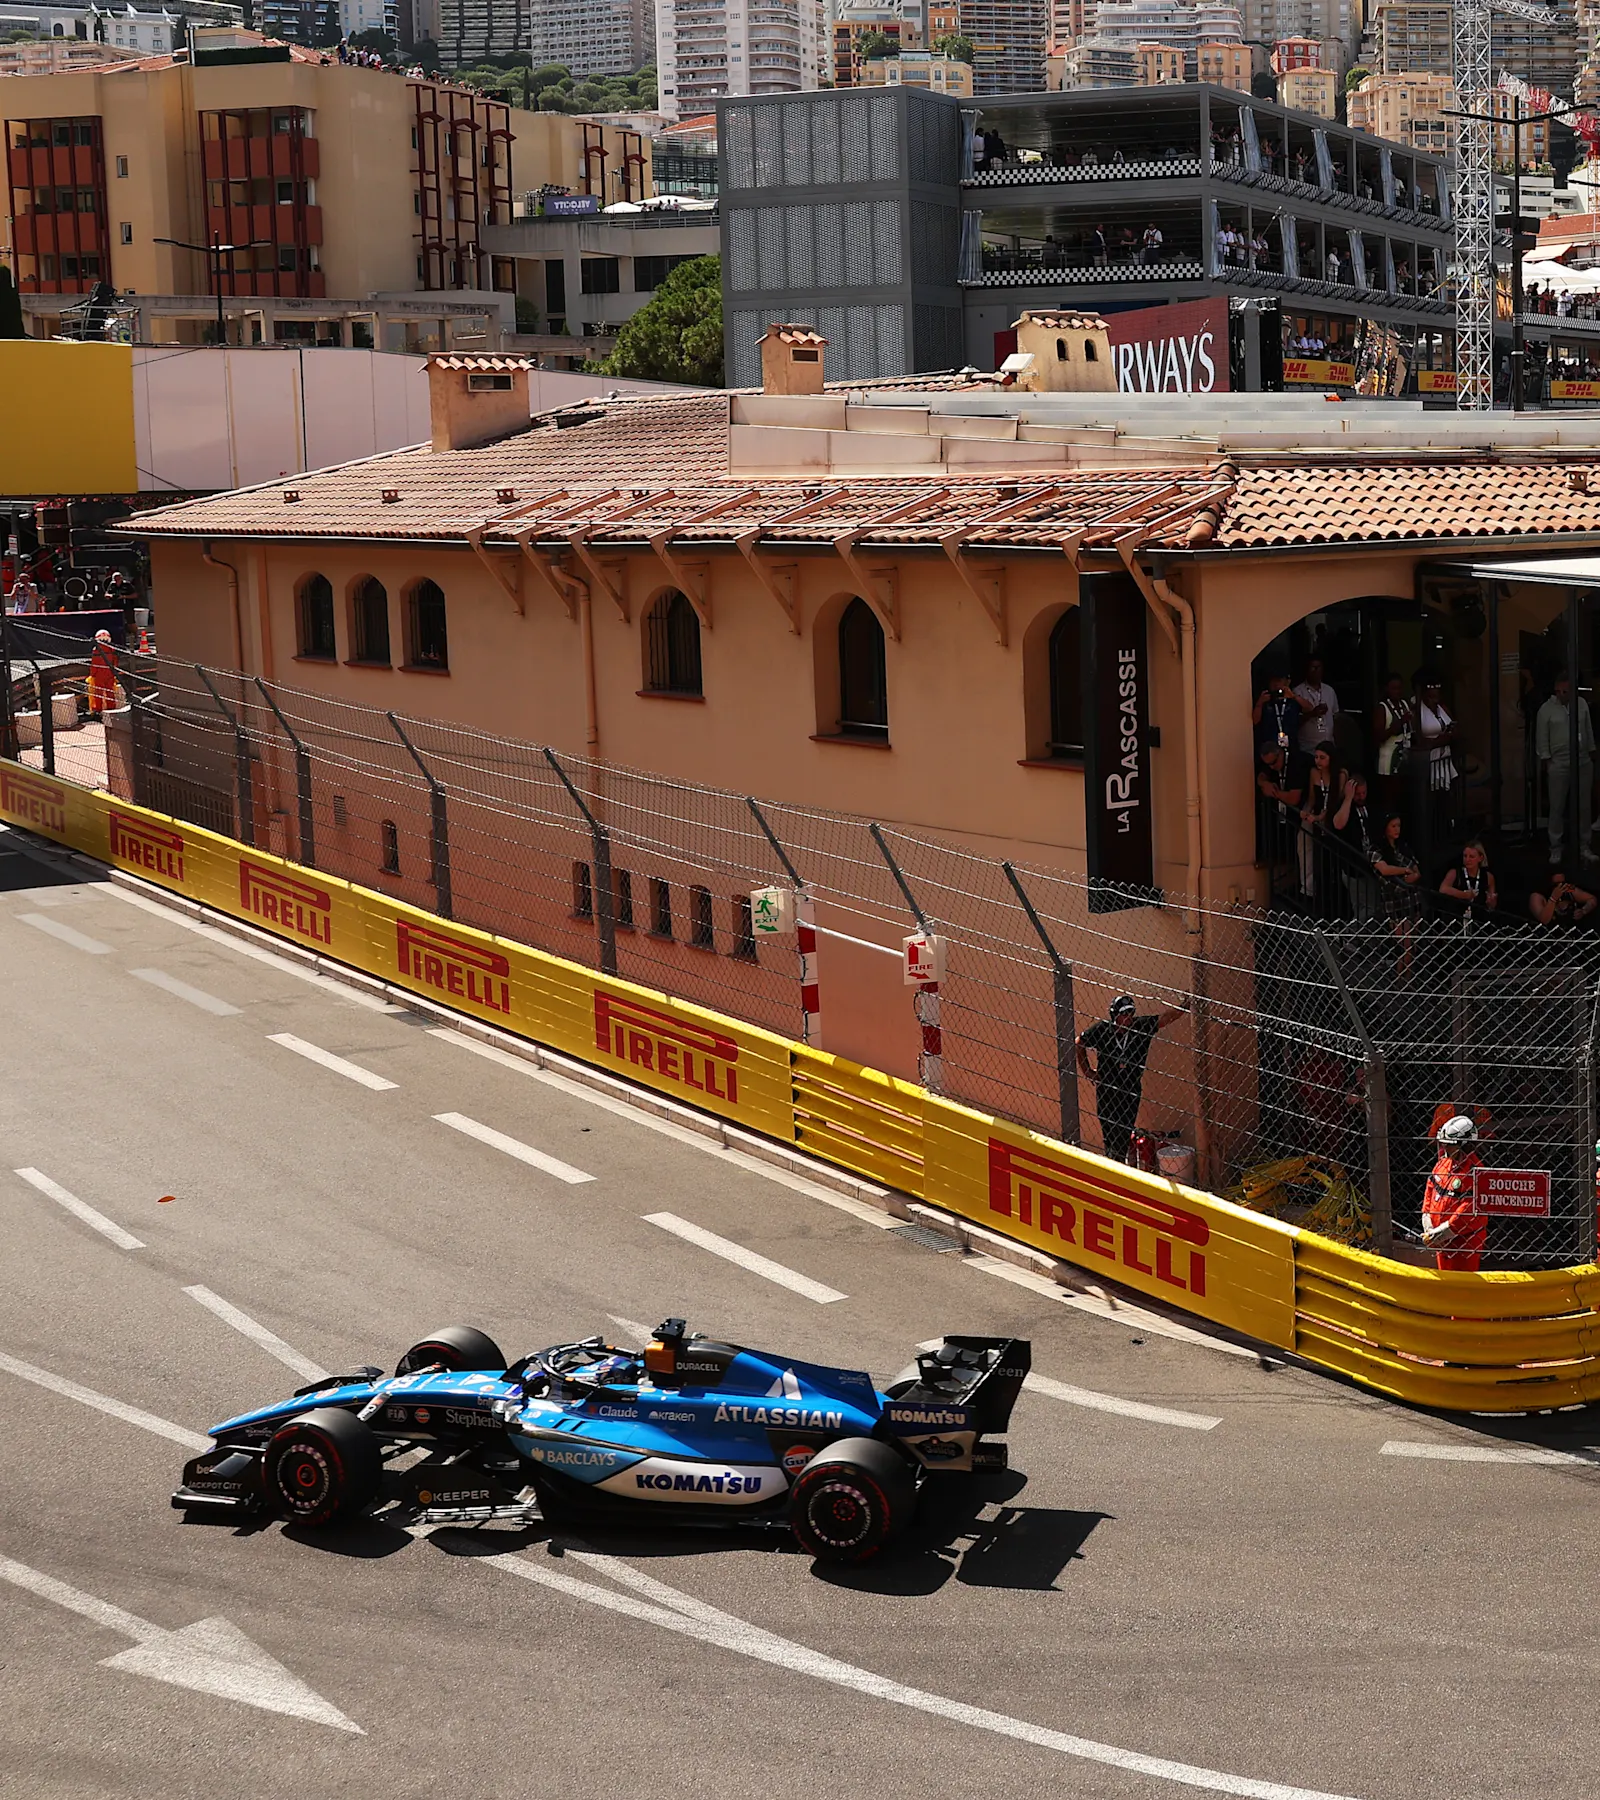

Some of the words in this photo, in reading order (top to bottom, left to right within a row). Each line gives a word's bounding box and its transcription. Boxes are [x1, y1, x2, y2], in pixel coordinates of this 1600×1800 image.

[1329, 366, 1350, 381] DHL
[1565, 383, 1594, 396] DHL
[1106, 648, 1140, 810] RASCASSE
[0, 769, 65, 834] PIRELLI
[1117, 810, 1130, 833] LA
[109, 809, 184, 882] PIRELLI
[240, 859, 332, 945] PIRELLI
[397, 918, 511, 1015] PIRELLI
[908, 963, 934, 971] FIRE
[594, 988, 738, 1104] PIRELLI
[1488, 1178, 1536, 1191] BOUCHE
[1480, 1194, 1544, 1208] D'INCENDIE
[988, 1136, 1211, 1298] PIRELLI
[676, 1362, 721, 1372] DURACELL
[446, 1409, 502, 1428] Stephens
[599, 1405, 639, 1418] Claude
[659, 1410, 696, 1421] kraken
[714, 1405, 843, 1429] ATLASSIAN
[890, 1410, 966, 1424] KOMATSU
[548, 1450, 616, 1466] BARCLAYS
[188, 1480, 222, 1490] JACKPOT
[222, 1481, 244, 1490] CITY
[636, 1472, 761, 1494] KOMATSU
[432, 1489, 490, 1502] KEEPER
